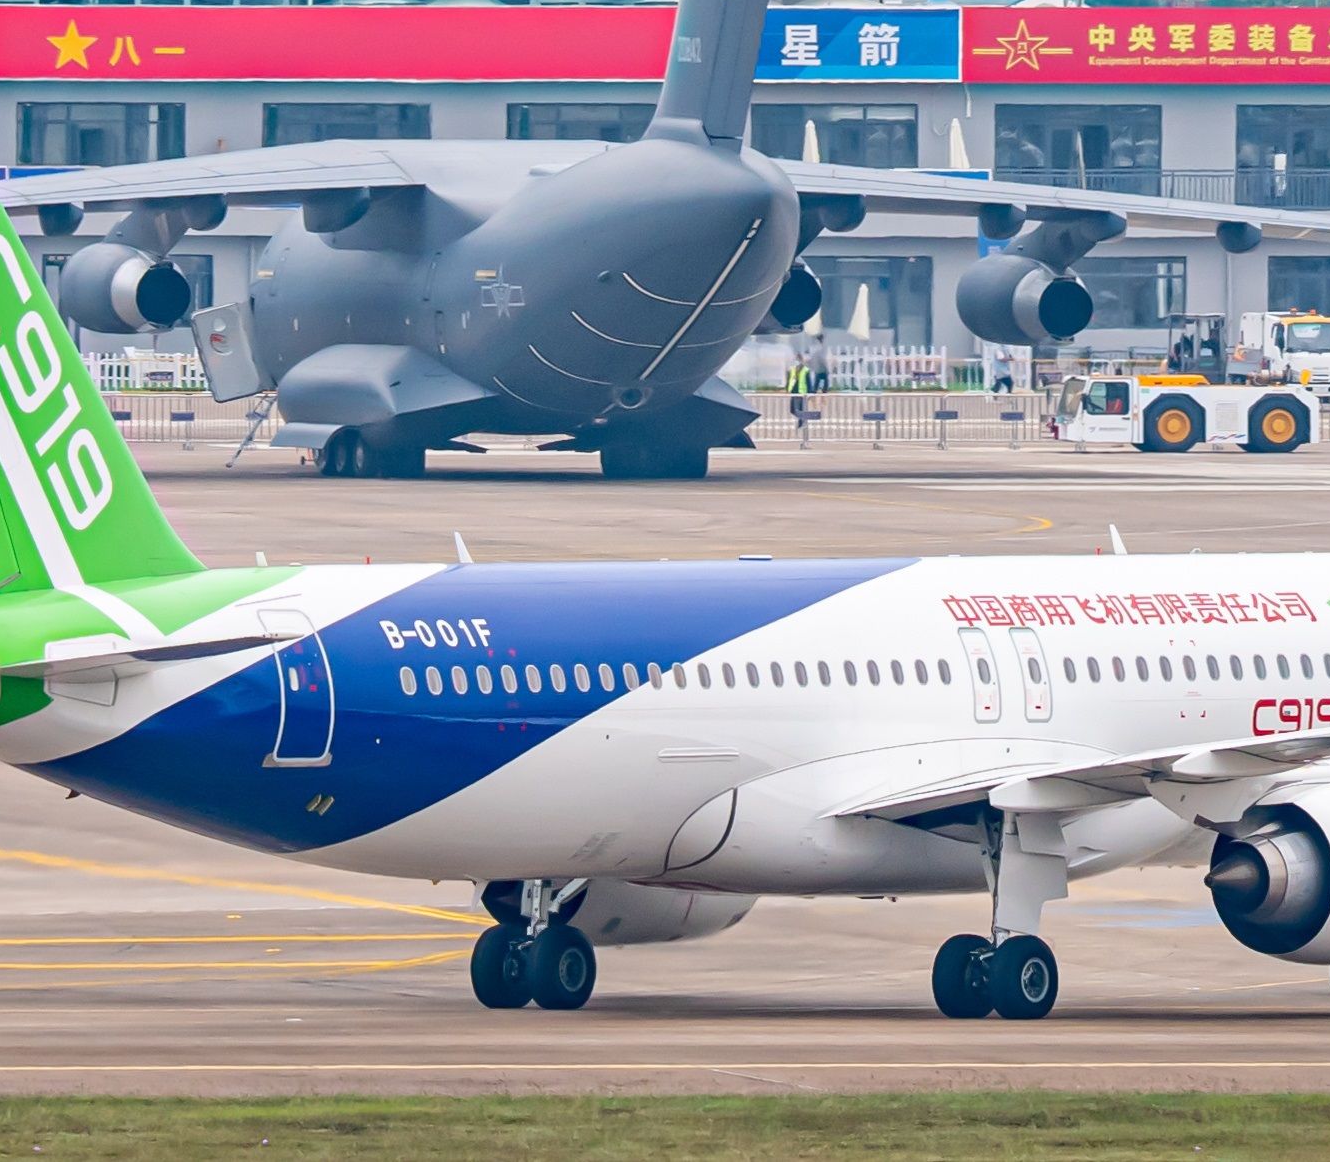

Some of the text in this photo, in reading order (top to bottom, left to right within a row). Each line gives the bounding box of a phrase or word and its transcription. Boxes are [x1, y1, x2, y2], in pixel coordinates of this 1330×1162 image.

[109, 36, 185, 66] 八一
[781, 23, 900, 66] 星箭
[941, 592, 1317, 627] 中国商用飞机有限责任公司
[379, 618, 491, 649] B-001F
